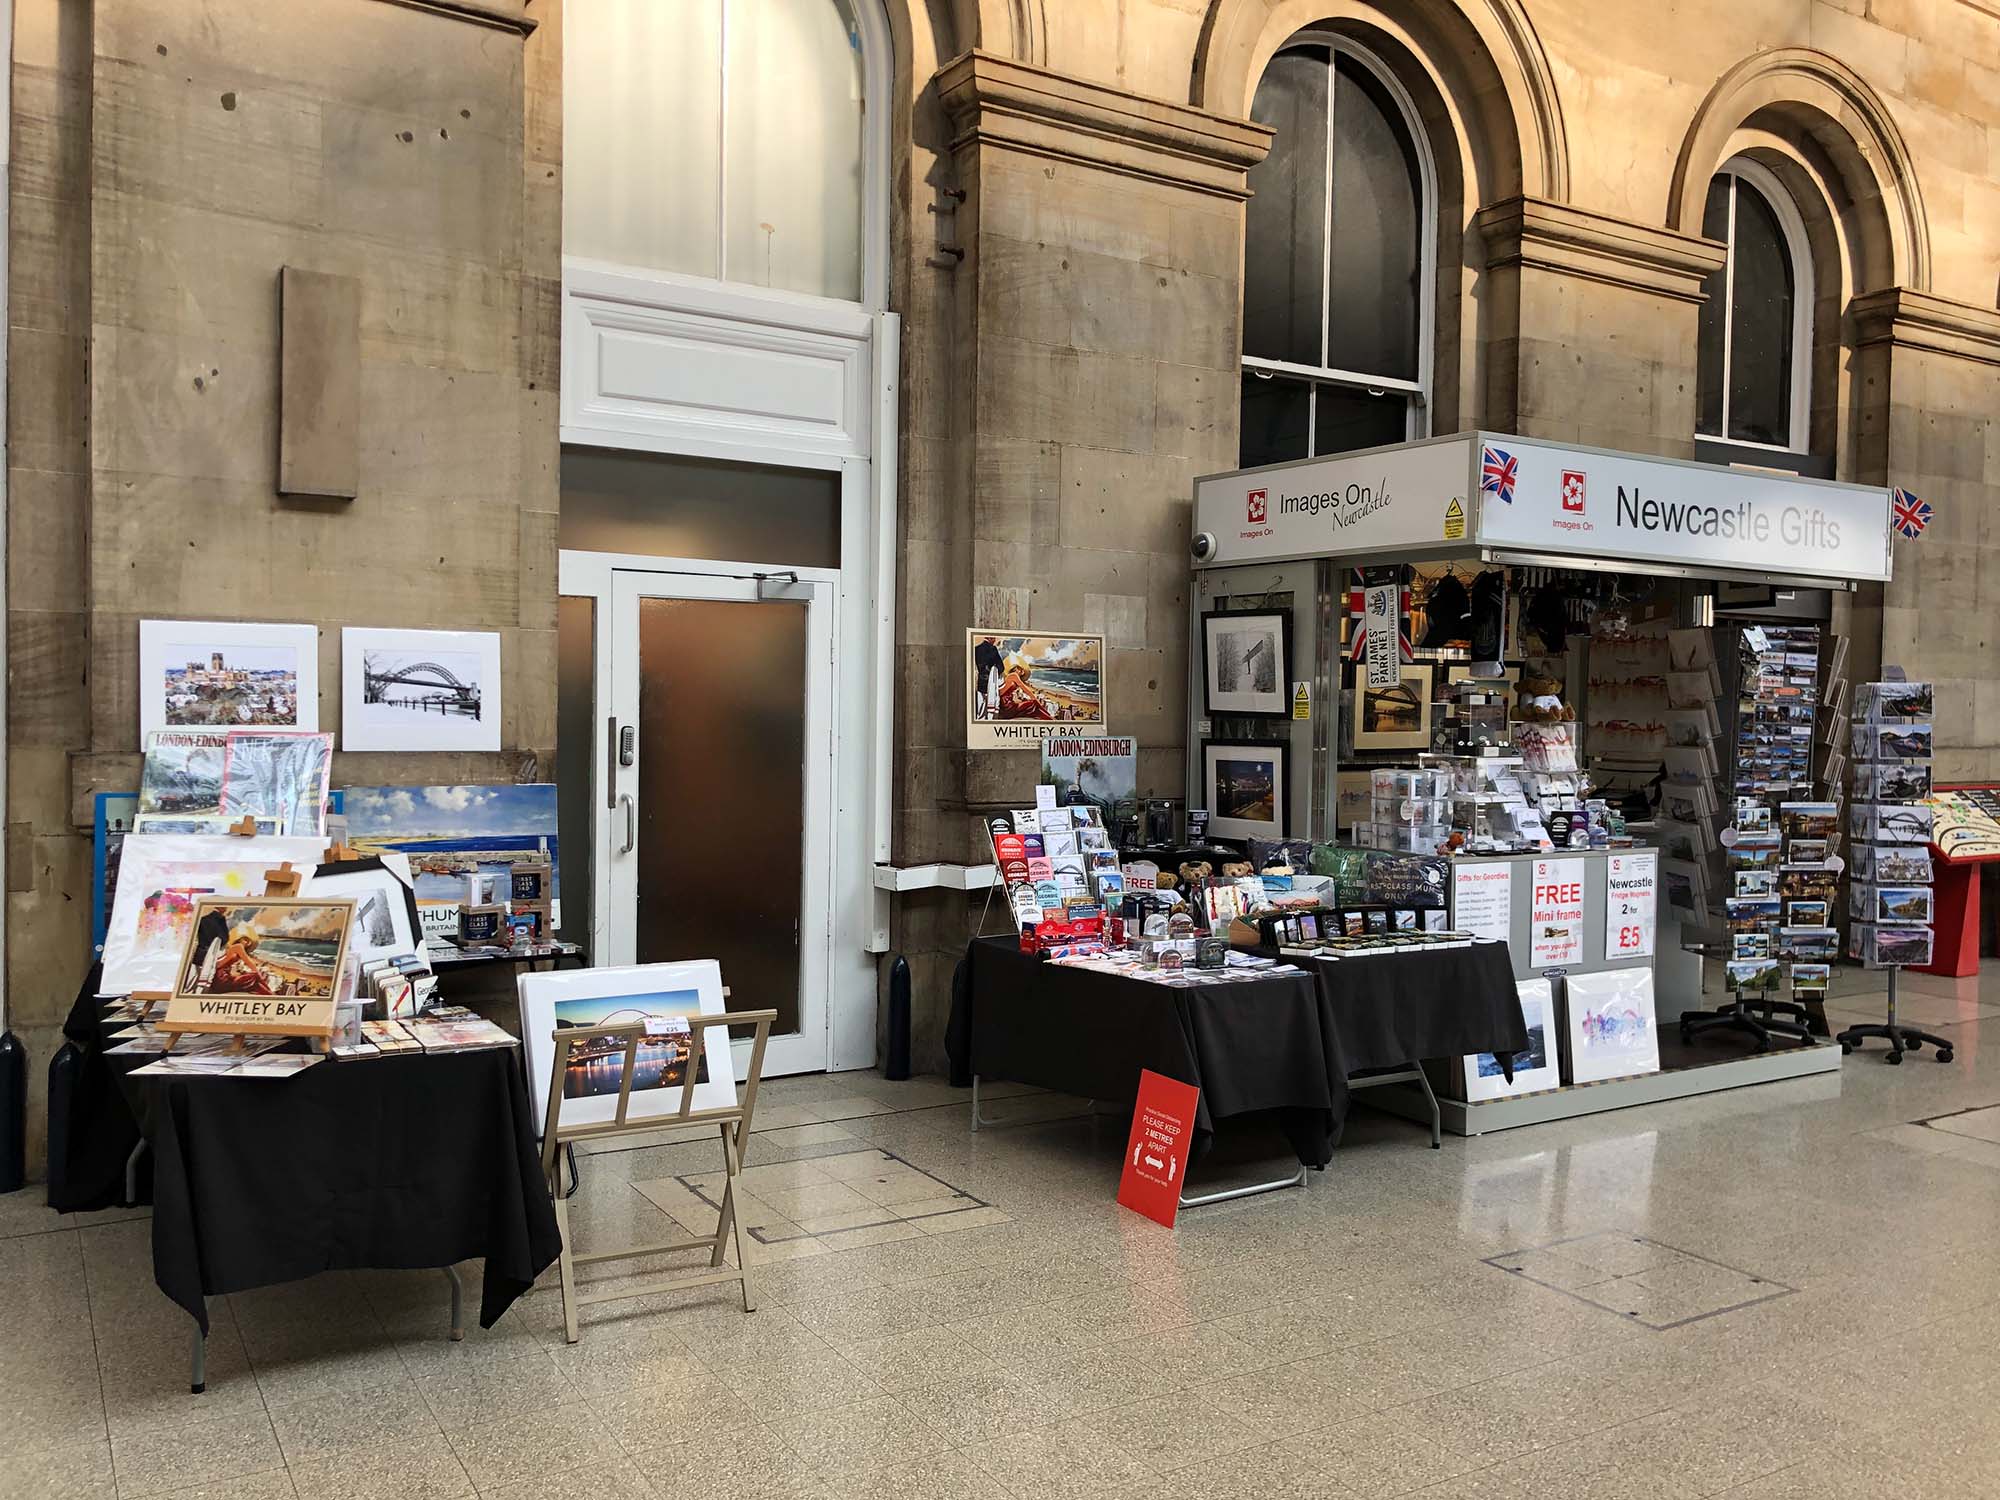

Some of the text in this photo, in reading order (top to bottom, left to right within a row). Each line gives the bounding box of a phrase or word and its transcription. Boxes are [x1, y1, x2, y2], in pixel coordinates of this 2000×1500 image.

[1280, 484, 1371, 516] Images On
[1333, 477, 1392, 531] Newcastle
[1617, 485, 1841, 549] Newcastle Gifts
[1552, 519, 1593, 532] Images On
[1240, 528, 1274, 540] Images On
[1369, 629, 1380, 684] ST. JAMES'
[1378, 630, 1389, 683] PARK NE1
[994, 726, 1083, 738] WHITLEY BAY
[1048, 740, 1131, 757] LONDON-EDINBURGH
[1126, 877, 1154, 890] FREE
[1415, 884, 1435, 893] MUM
[1609, 877, 1653, 890] Newcastle
[1384, 892, 1408, 900] ONLY
[1536, 884, 1581, 905] FREE
[1611, 892, 1629, 900] Fridge
[1534, 910, 1582, 922] Mini frame
[1622, 904, 1638, 915] 2 for
[1619, 926, 1640, 948] £5
[1550, 944, 1561, 952] you
[1561, 940, 1577, 951] spend
[200, 1002, 307, 1016] WHITLEY BAY
[1142, 1114, 1181, 1136] PLEASE KEEP
[1145, 1127, 1174, 1146] 2 METRES
[1148, 1140, 1167, 1154] APART
